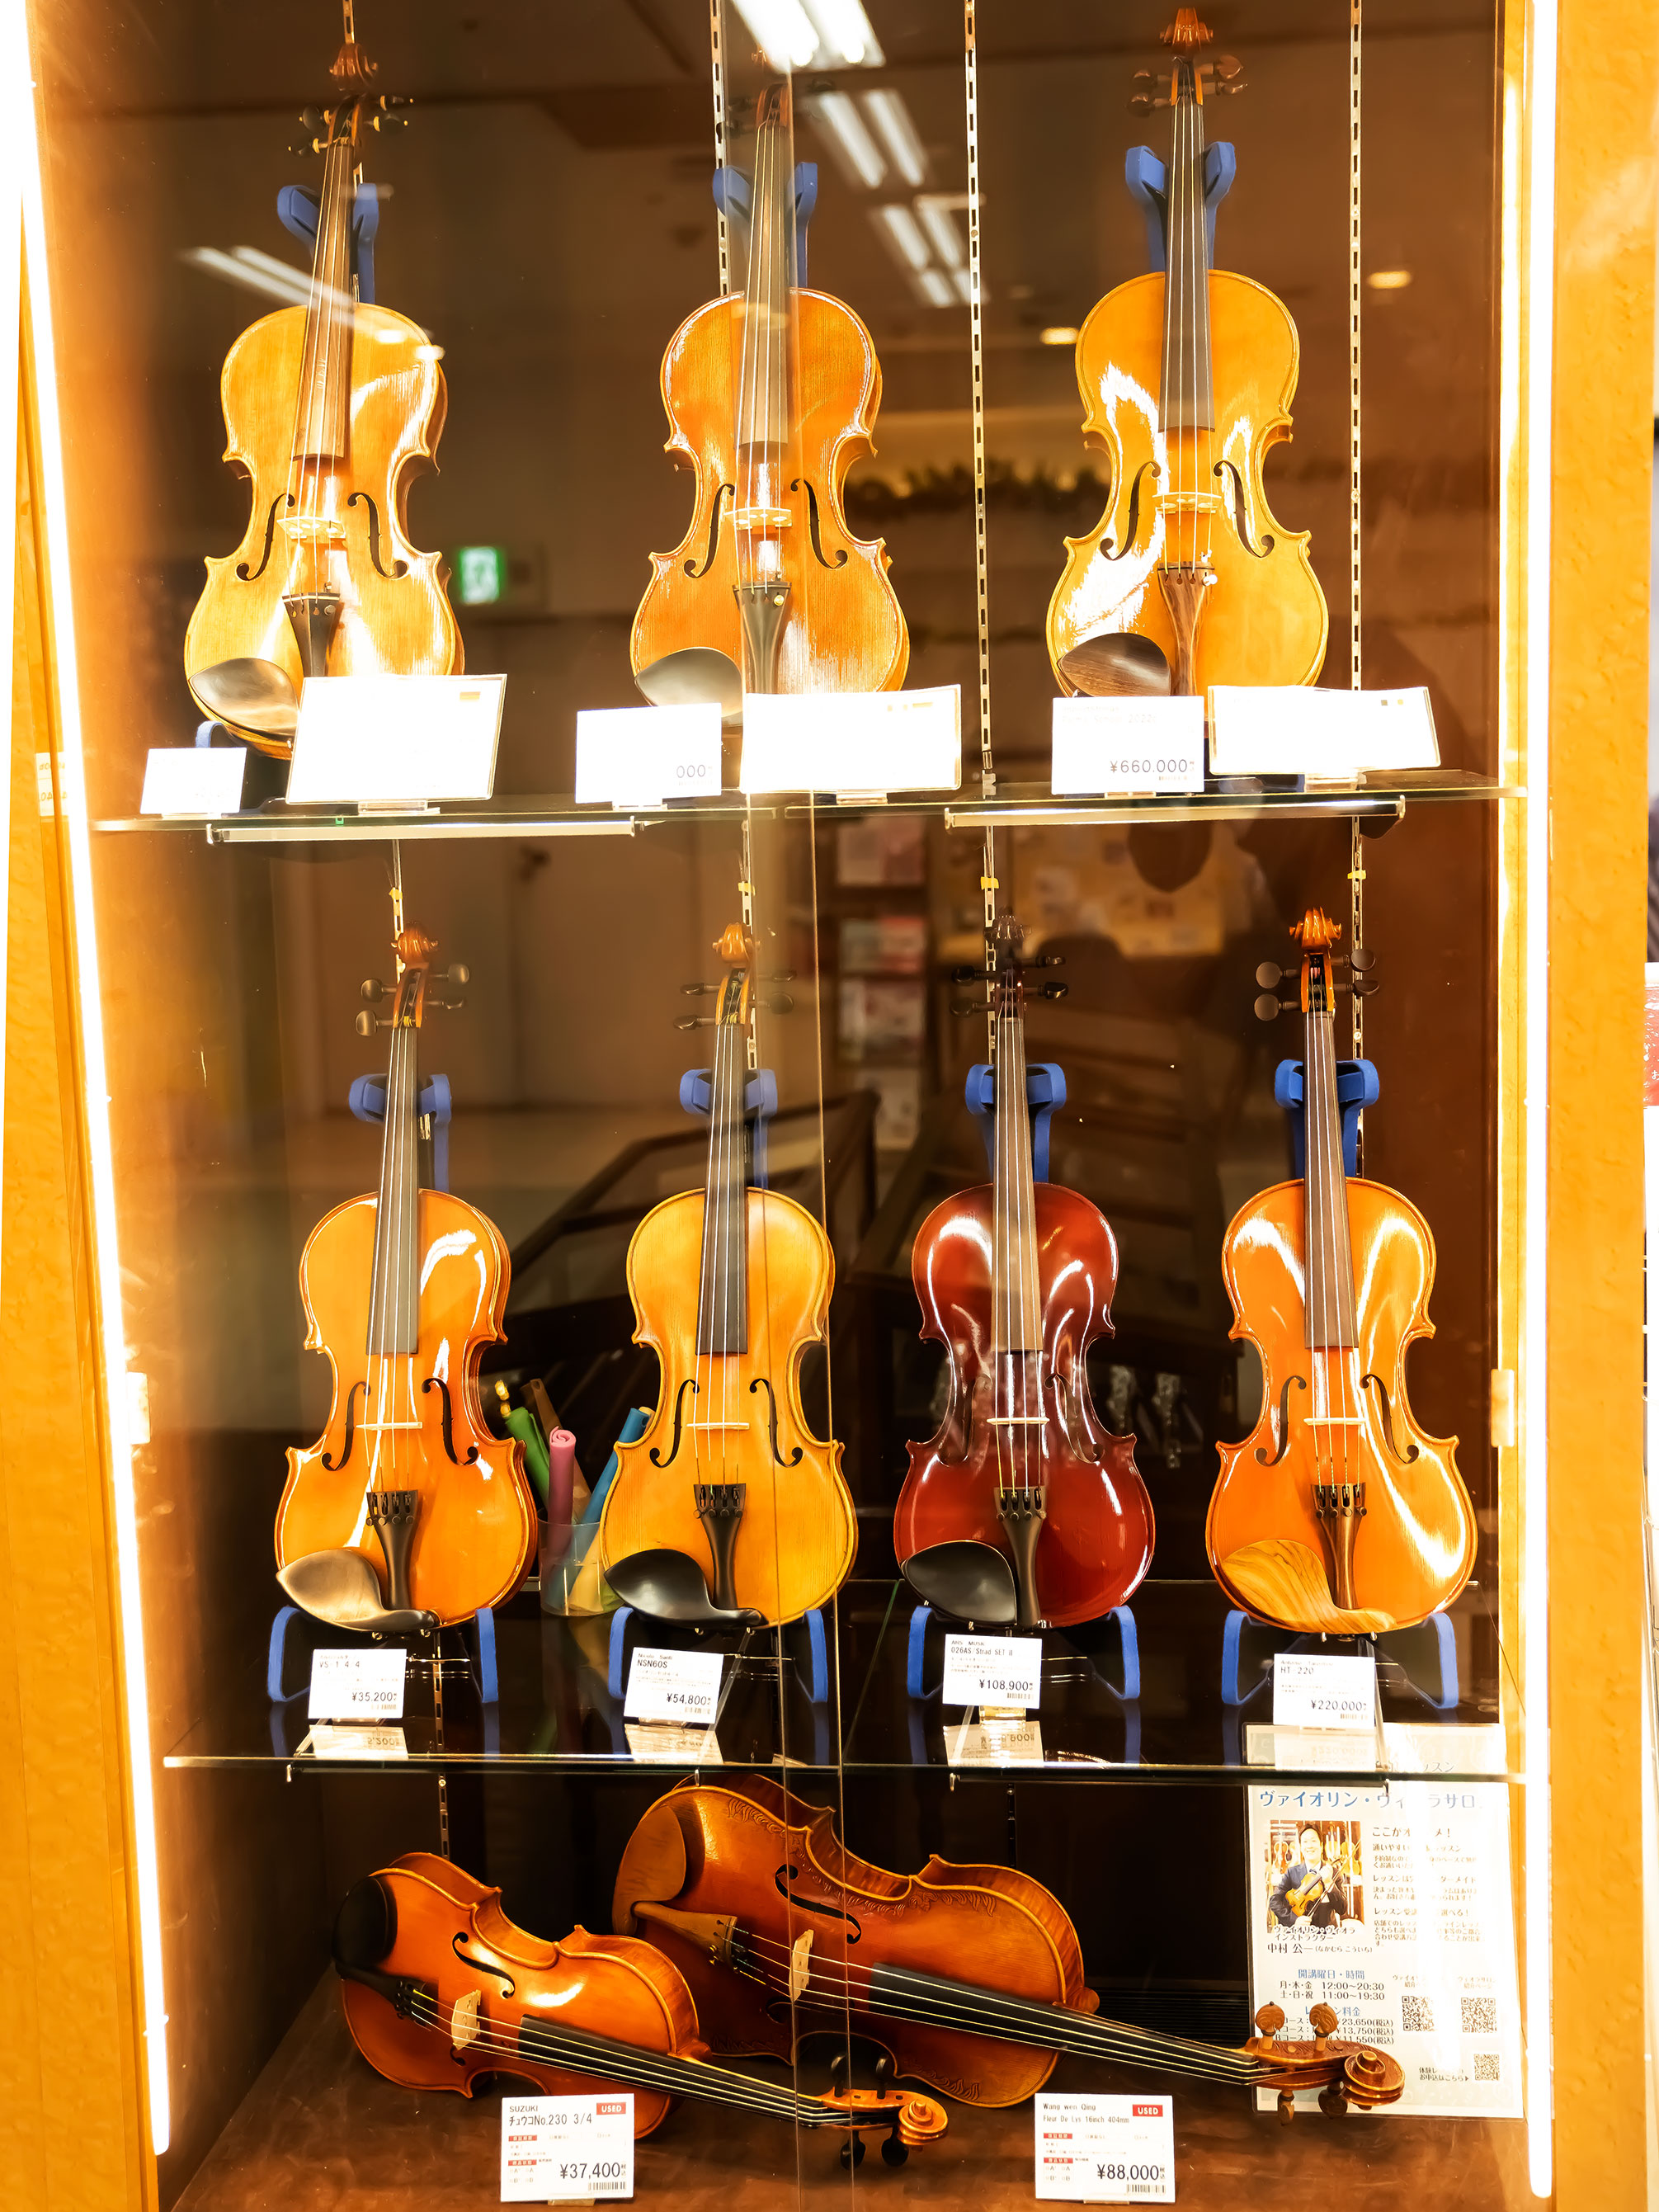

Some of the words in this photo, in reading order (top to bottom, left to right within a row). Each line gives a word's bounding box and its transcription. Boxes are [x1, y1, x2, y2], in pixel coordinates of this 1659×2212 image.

[637, 1658, 668, 1669] NSN60S
[979, 1679, 1029, 1691] ¥108,900
[666, 1692, 707, 1706] ¥54,800
[1267, 1943, 1288, 1954] 中村
[1298, 1969, 1365, 1979] 開講曜日・時間
[509, 2105, 539, 2113] SUZUKI
[601, 2105, 622, 2113] USED
[1081, 2103, 1096, 2111] Qing
[573, 2113, 592, 2125] 3/4
[559, 2162, 621, 2180] ¥37,400
[1097, 2163, 1159, 2181] ¥88,000
